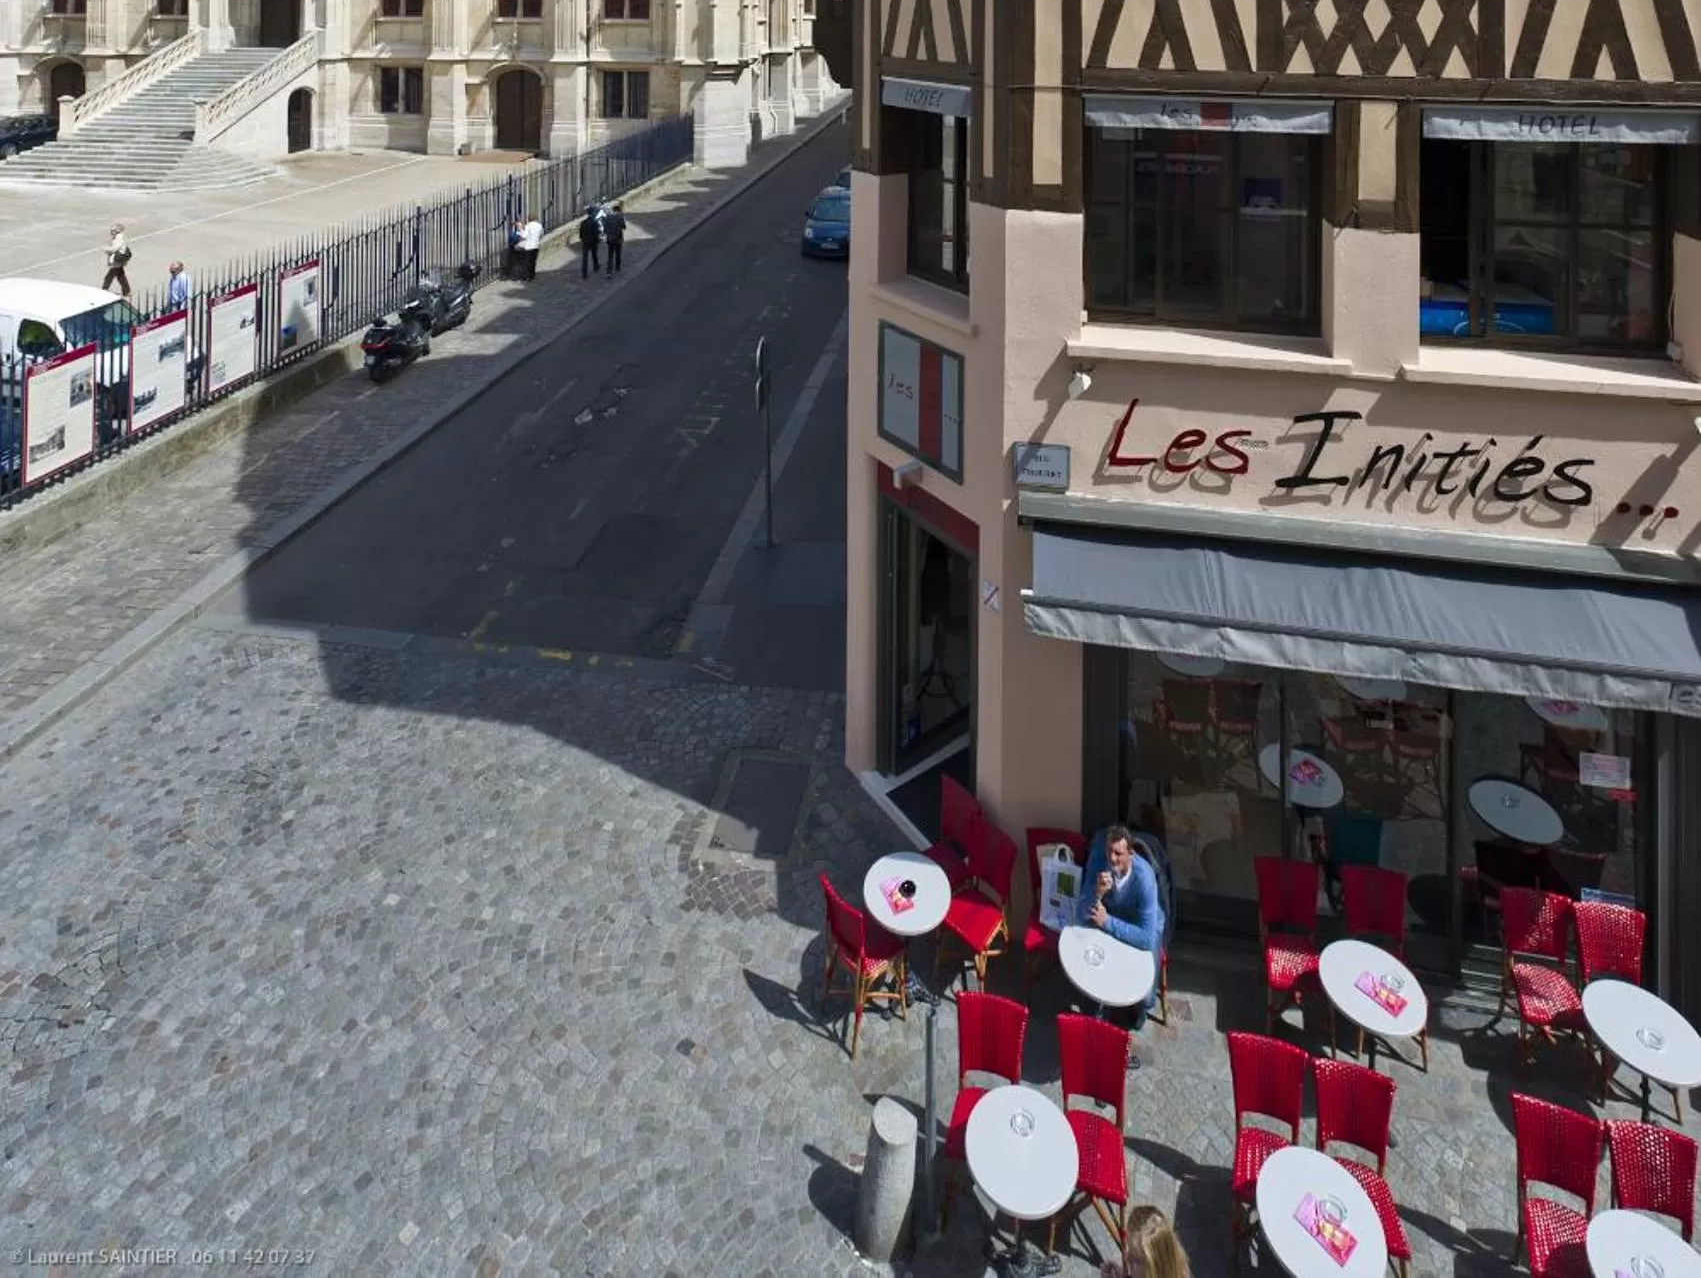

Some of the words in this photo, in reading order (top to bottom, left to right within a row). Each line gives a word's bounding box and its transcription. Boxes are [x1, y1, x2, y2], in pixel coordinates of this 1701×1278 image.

[1517, 113, 1601, 136] HOTEL
[1109, 398, 1254, 475] Les
[1274, 410, 1595, 506] Initiés
